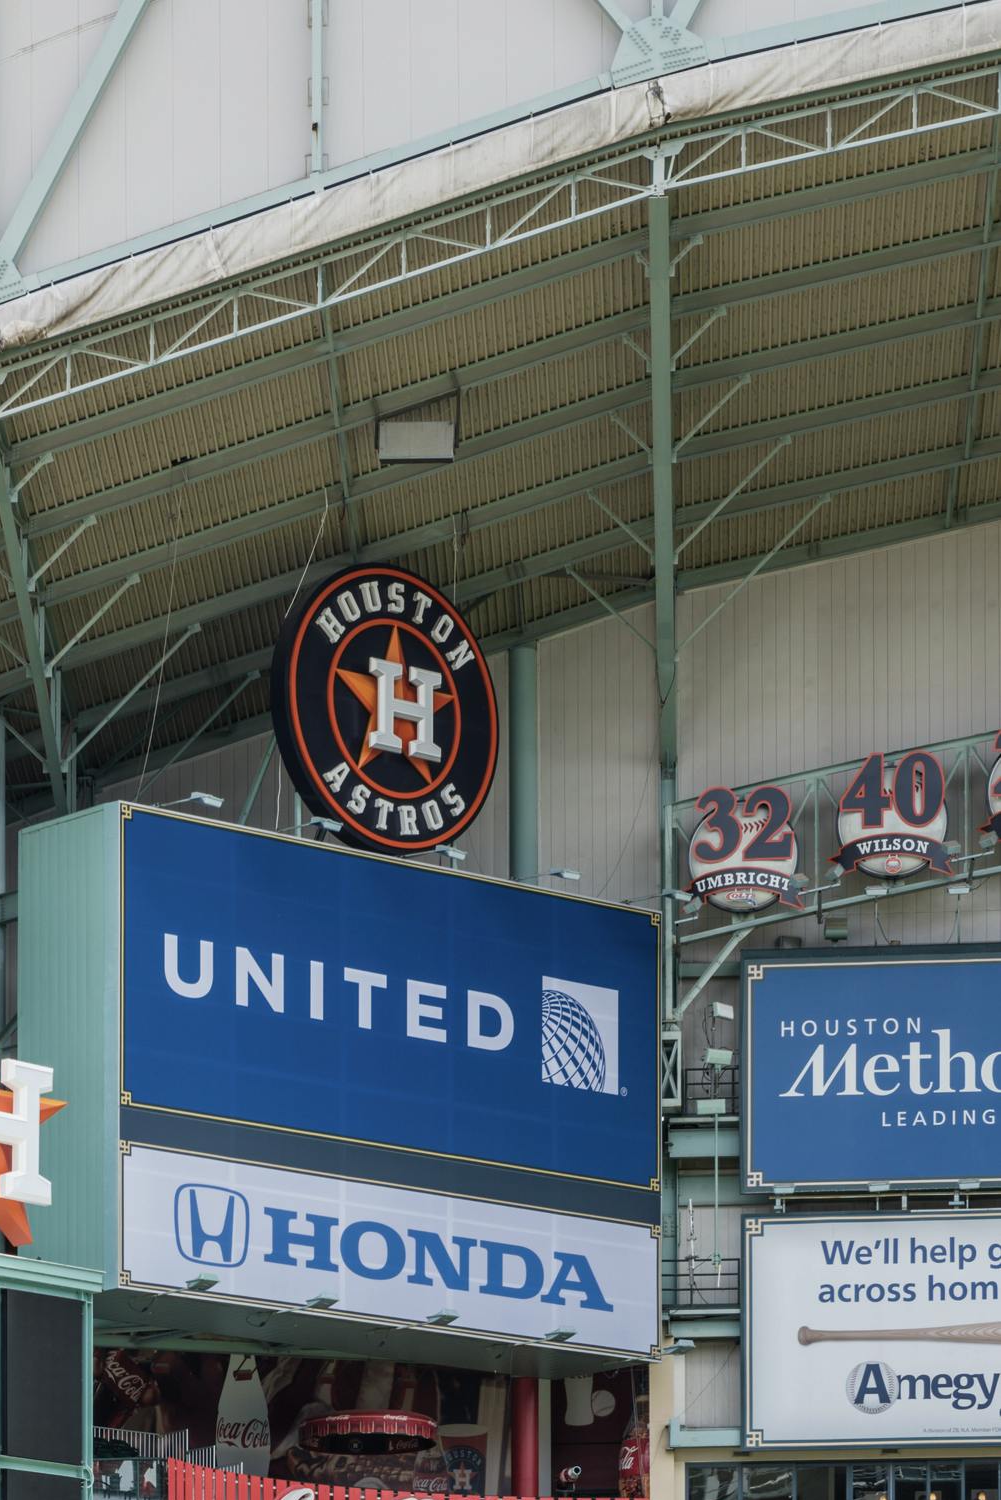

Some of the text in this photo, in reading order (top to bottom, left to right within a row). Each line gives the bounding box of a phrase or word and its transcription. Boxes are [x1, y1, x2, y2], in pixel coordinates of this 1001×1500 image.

[315, 580, 475, 672] HOUSTON
[322, 761, 466, 836] ASTROS
[839, 749, 946, 829] 40
[694, 785, 794, 864] 32
[856, 838, 930, 854] WILSON
[695, 871, 790, 893] UMBRICHT
[163, 933, 516, 1052] UNITED
[780, 1017, 922, 1038] HOUSTON
[881, 1109, 996, 1127] LEADING
[263, 1207, 614, 1312] HONDA
[910, 1237, 977, 1270] help
[818, 1275, 999, 1303] across hom
[853, 1363, 1001, 1410] Amegy
[216, 1417, 269, 1449] Coca-Cola
